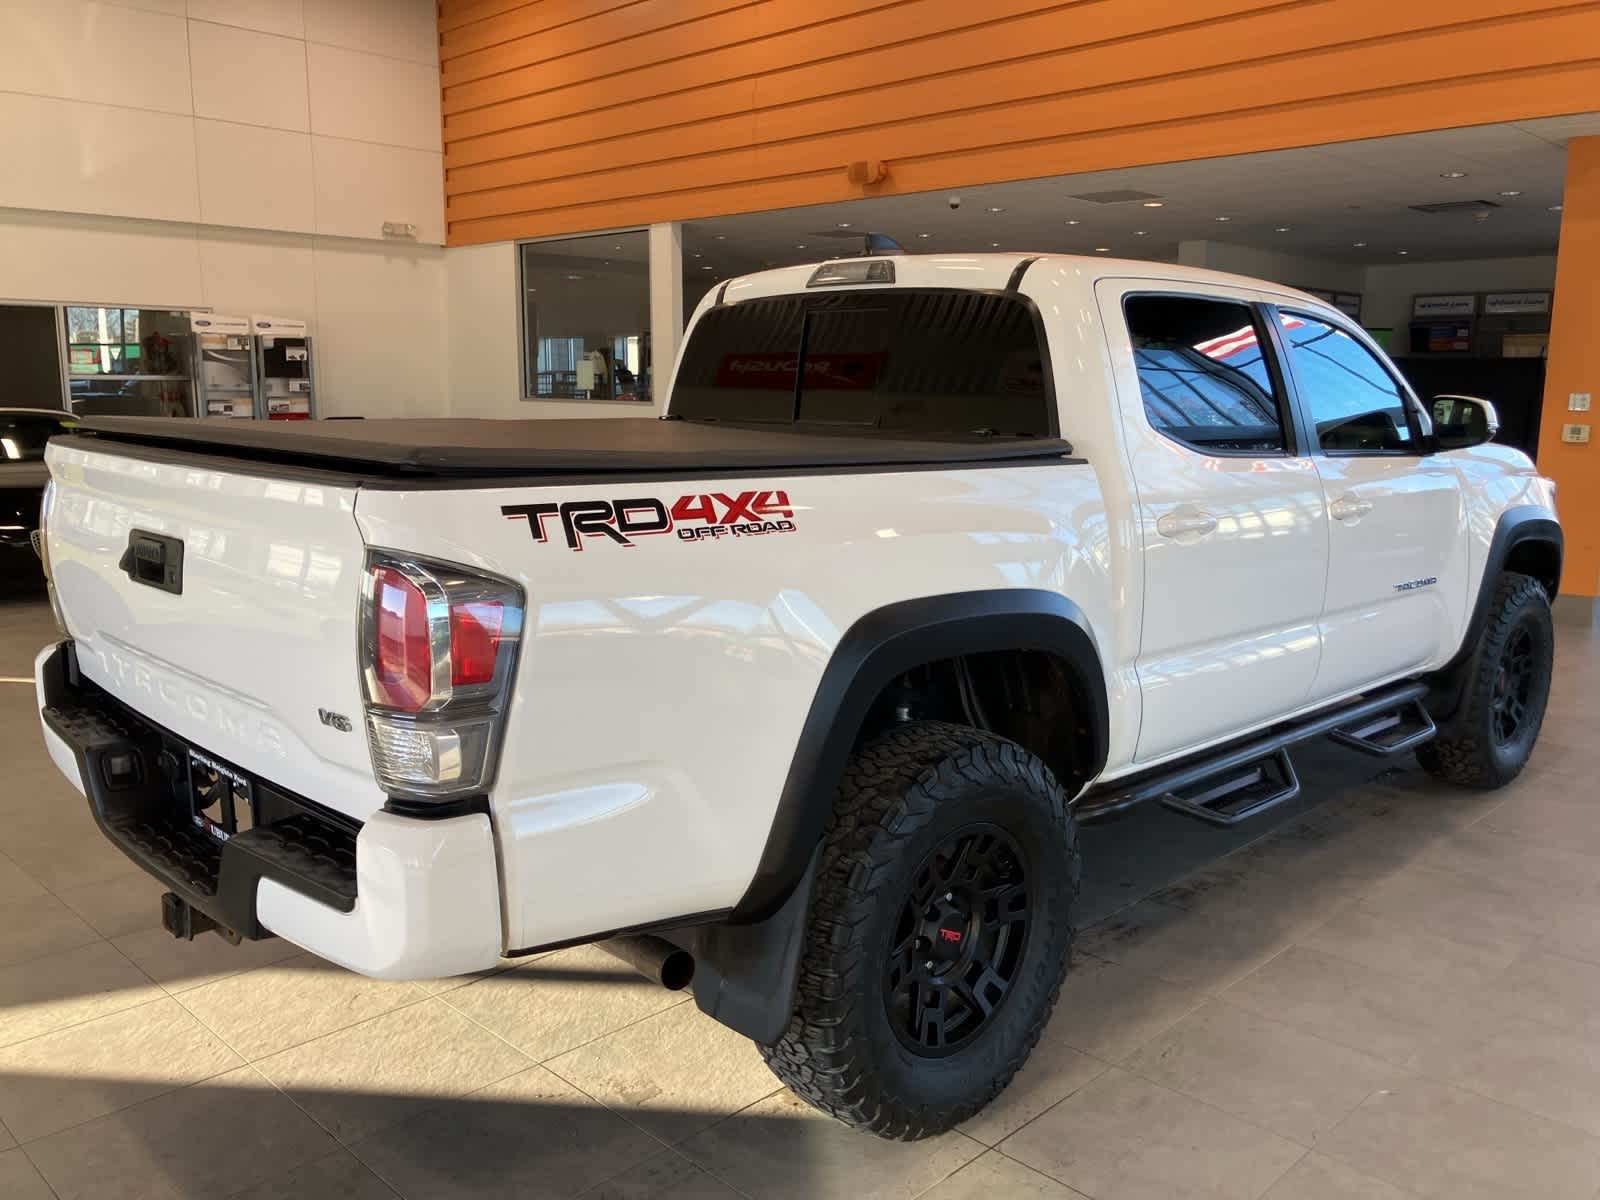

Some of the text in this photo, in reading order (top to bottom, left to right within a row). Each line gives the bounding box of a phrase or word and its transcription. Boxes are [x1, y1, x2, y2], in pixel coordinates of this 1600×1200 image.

[500, 491, 795, 552] TRD 4X4
[677, 519, 799, 543] OFF ROAD
[317, 707, 353, 733] V6
[939, 927, 961, 942] TRD
